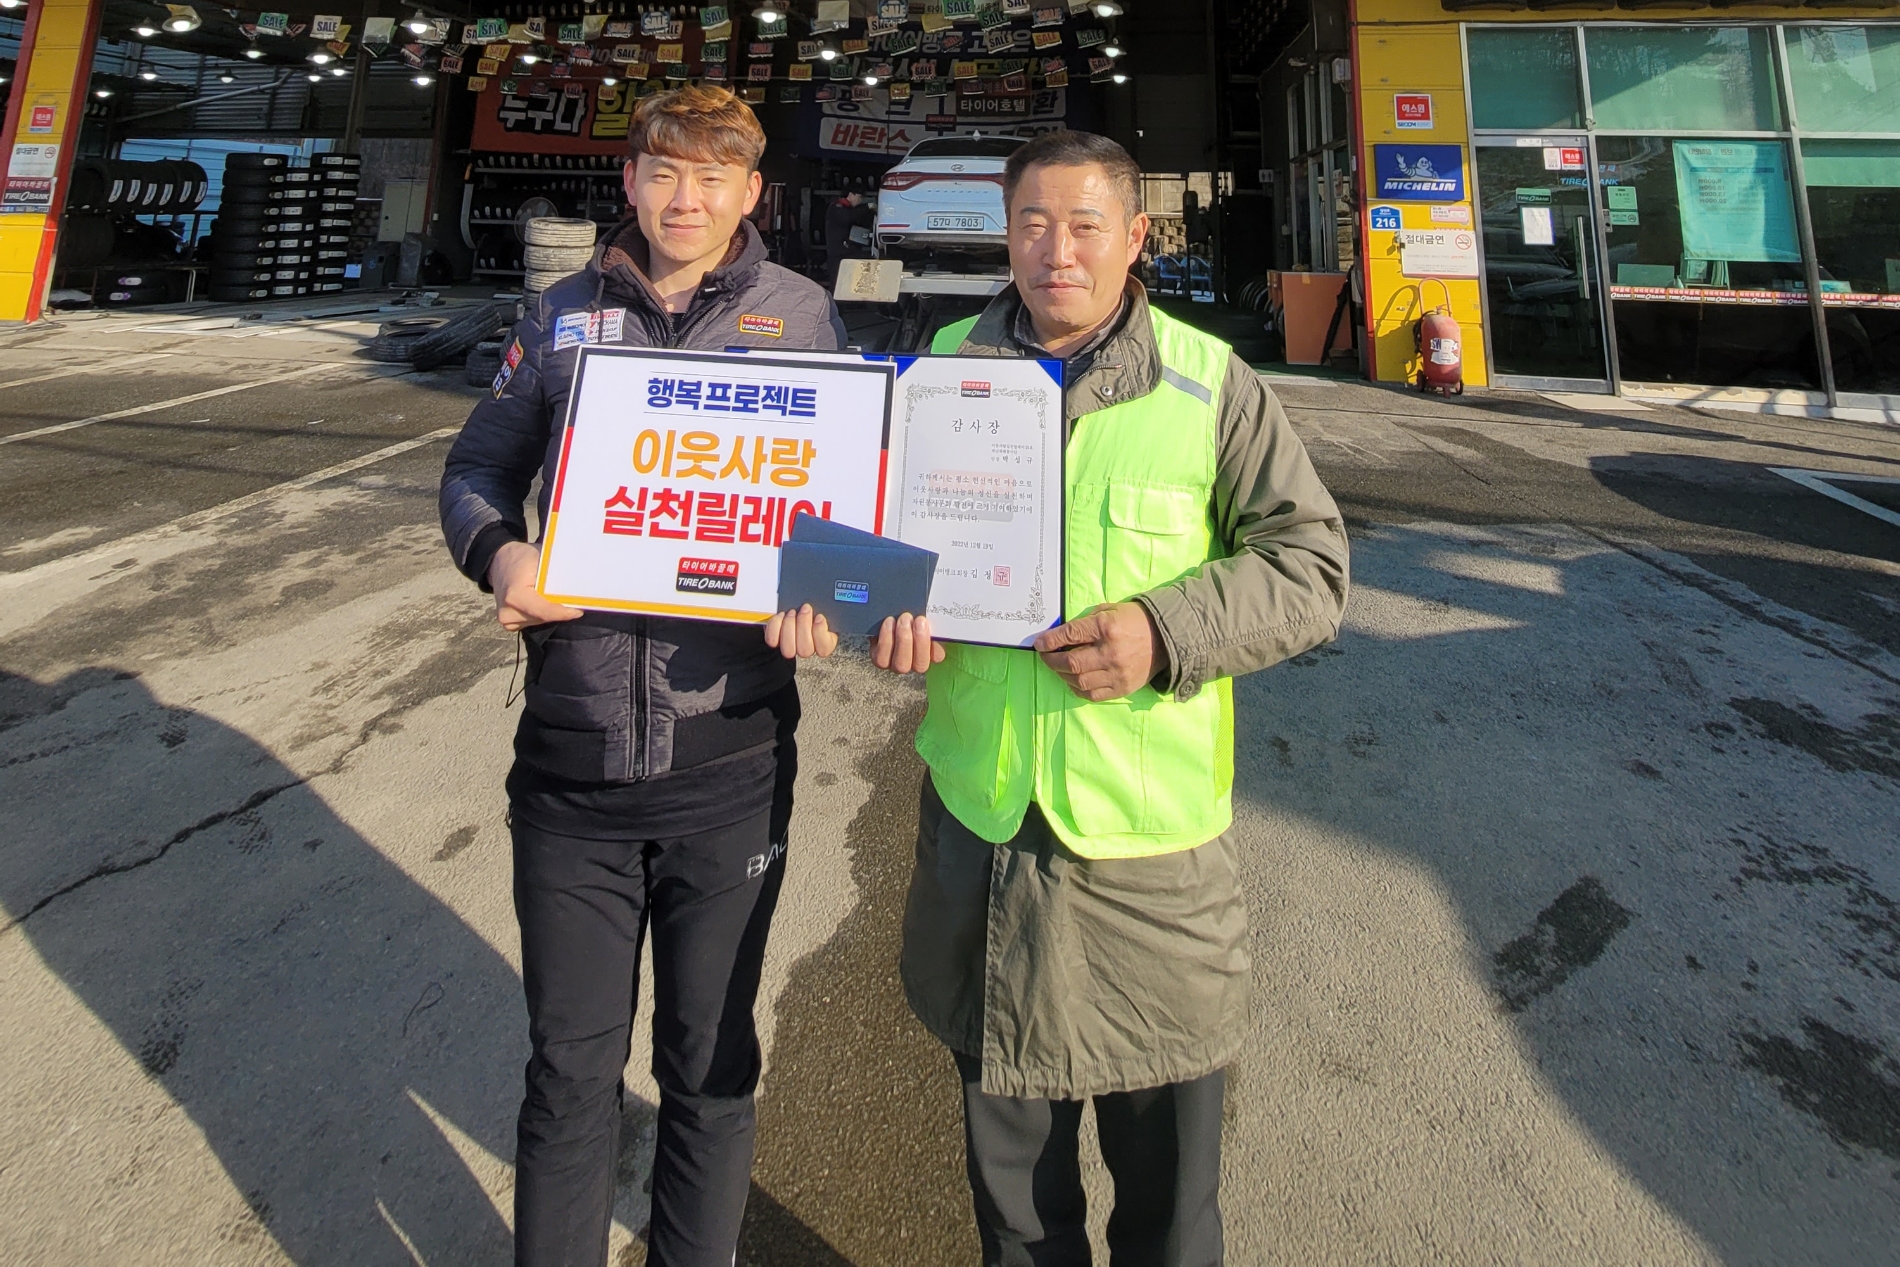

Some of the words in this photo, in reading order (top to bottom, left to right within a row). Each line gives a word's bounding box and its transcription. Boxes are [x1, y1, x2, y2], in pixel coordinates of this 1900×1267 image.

[881, 3, 907, 19] SALE
[946, 1, 972, 15] SALE
[262, 15, 284, 29] SALE
[316, 20, 338, 32] SALE
[644, 16, 669, 30] SALE
[762, 23, 784, 33] SALE
[561, 29, 583, 40] SALE
[1036, 32, 1057, 44] SALE
[989, 34, 1010, 48] SALE
[617, 48, 636, 58] SALE
[660, 48, 679, 58] SALE
[704, 47, 723, 57] SALE
[751, 67, 768, 76] SALE
[915, 65, 933, 75] SALE
[956, 65, 975, 75] SALE
[960, 98, 1026, 114] 타이어호텔
[499, 91, 586, 133] 누구나
[830, 123, 913, 151] 바란스
[1384, 181, 1456, 192] MICHELIN
[955, 218, 979, 227] 7803
[1375, 218, 1397, 228] 216
[1405, 234, 1445, 245] 절대금연
[632, 428, 817, 488] 이웃사랑
[912, 485, 949, 495] 이웃사랑과
[681, 560, 736, 574] 타이어바꿀때
